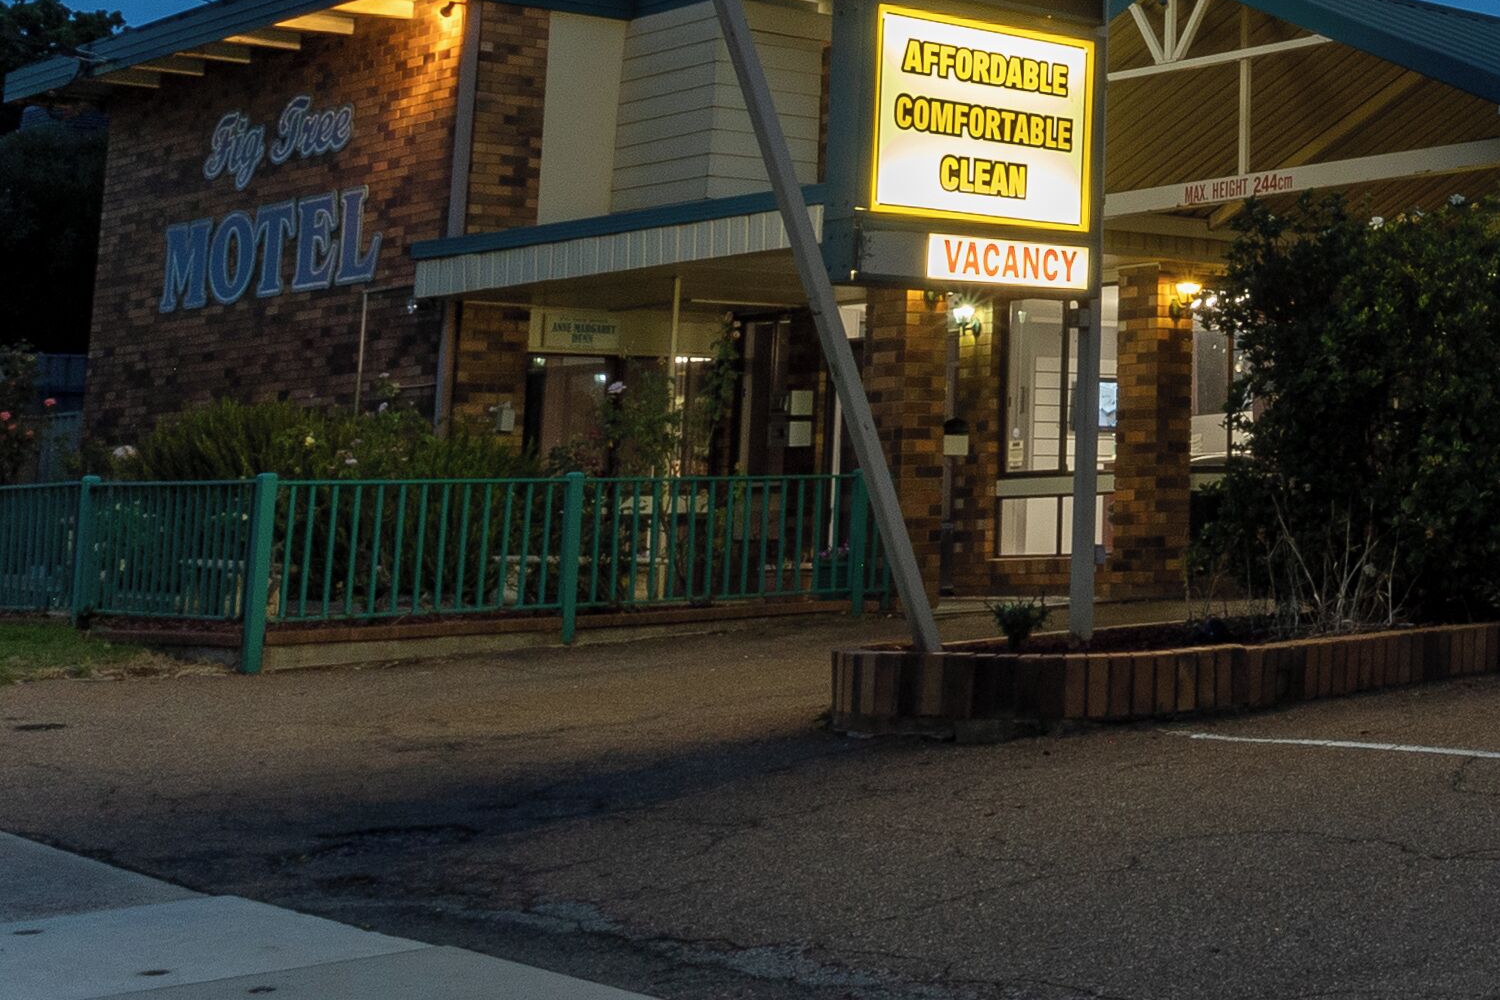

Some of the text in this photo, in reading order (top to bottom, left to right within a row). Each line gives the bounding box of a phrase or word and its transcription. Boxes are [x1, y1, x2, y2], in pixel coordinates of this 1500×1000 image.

[902, 38, 1069, 97] AFFORDABLE
[203, 96, 355, 192] Fig Tree
[894, 93, 1073, 153] COMFORTABLE
[939, 154, 1027, 200] CLEAN
[1184, 184, 1209, 204] MAX.
[1212, 177, 1249, 199] HEIGHT
[158, 185, 383, 314] MOTEL
[943, 239, 1078, 282] VACANCY
